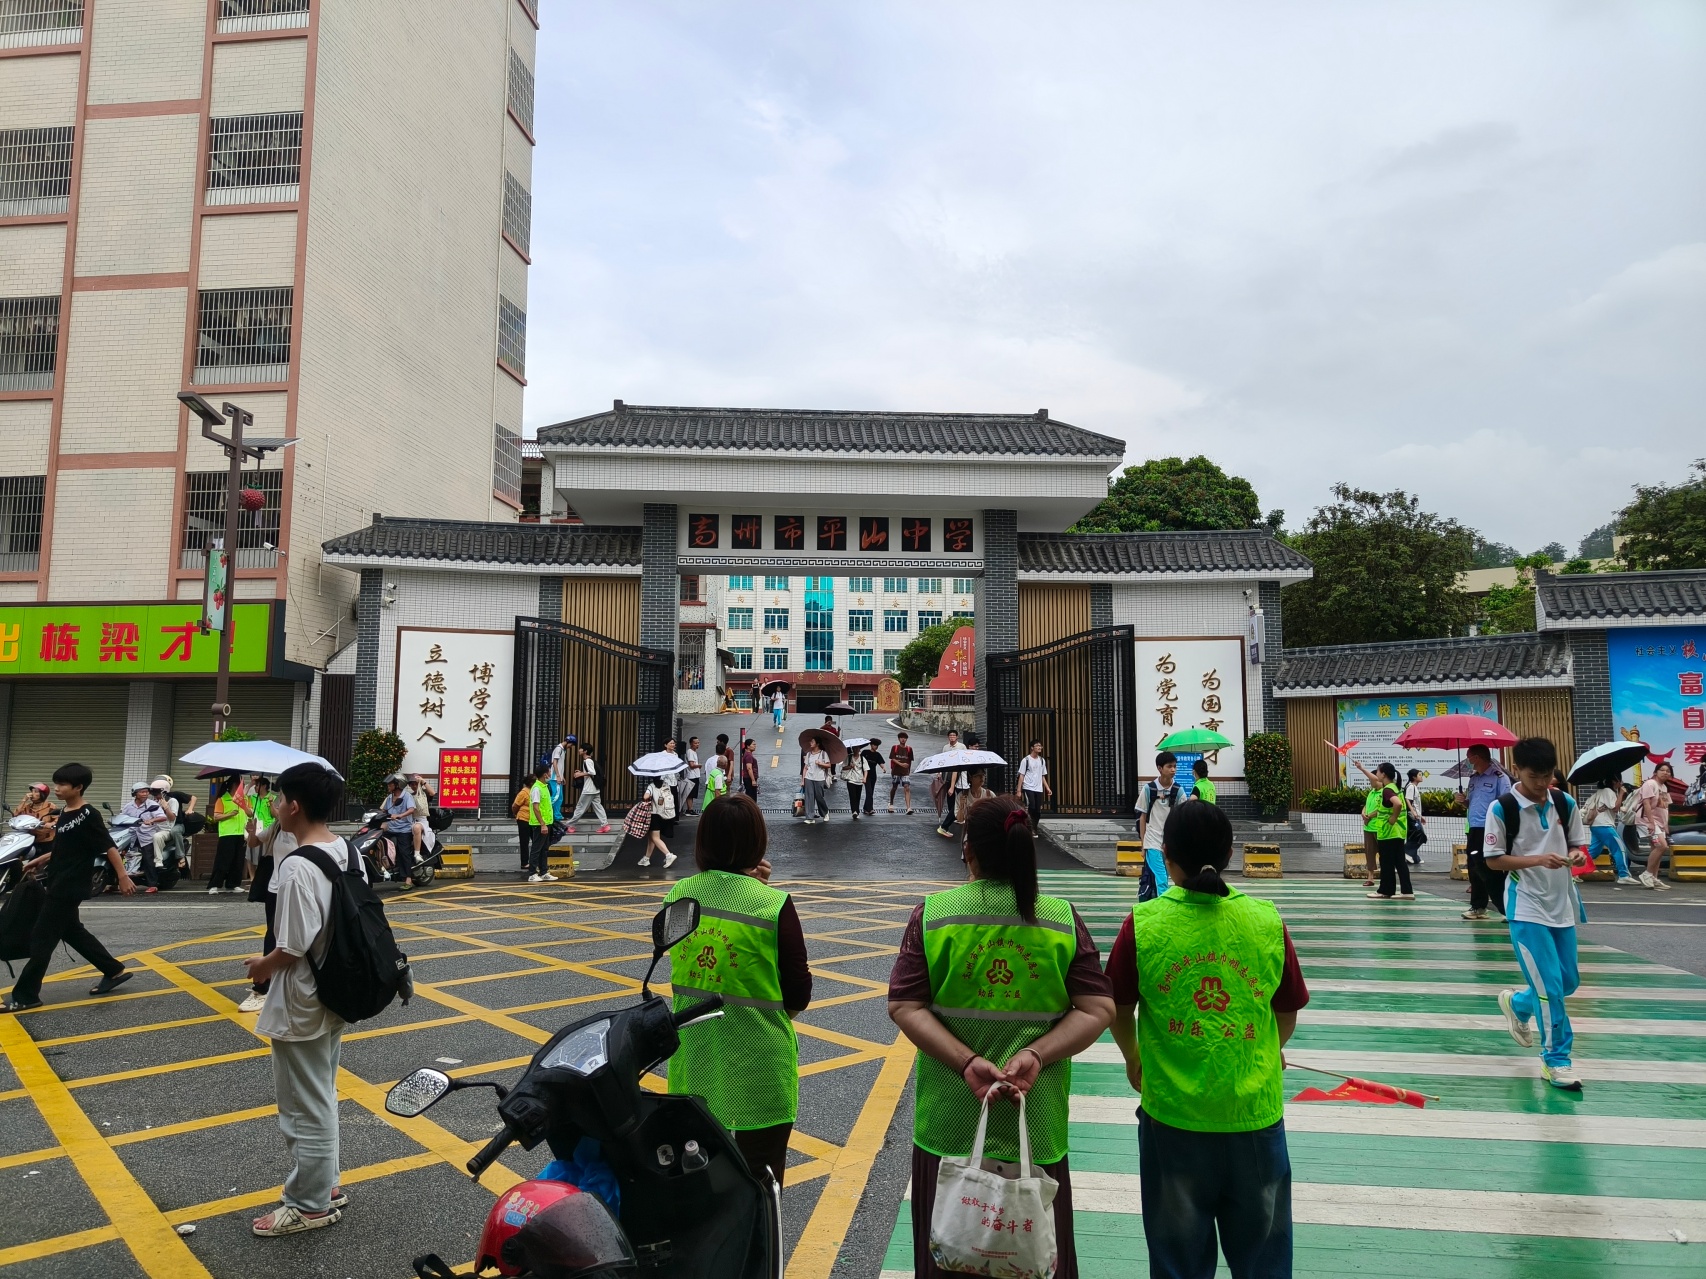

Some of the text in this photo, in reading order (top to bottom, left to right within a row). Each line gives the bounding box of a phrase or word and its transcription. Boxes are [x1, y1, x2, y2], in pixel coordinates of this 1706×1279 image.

[692, 517, 971, 550] 高州市平山中学
[1635, 640, 1706, 661] 社会主义核
[417, 643, 448, 743] 立德树人
[1678, 671, 1704, 695] 富
[1378, 702, 1449, 718] 校长寄语
[1682, 706, 1705, 730] 自
[442, 788, 476, 797] 禁止入内
[1157, 951, 1264, 998] 高州市平山镇巾帼志愿者
[1168, 1018, 1256, 1040] 助乐 公益
[981, 1216, 1034, 1235] 的奋斗者
